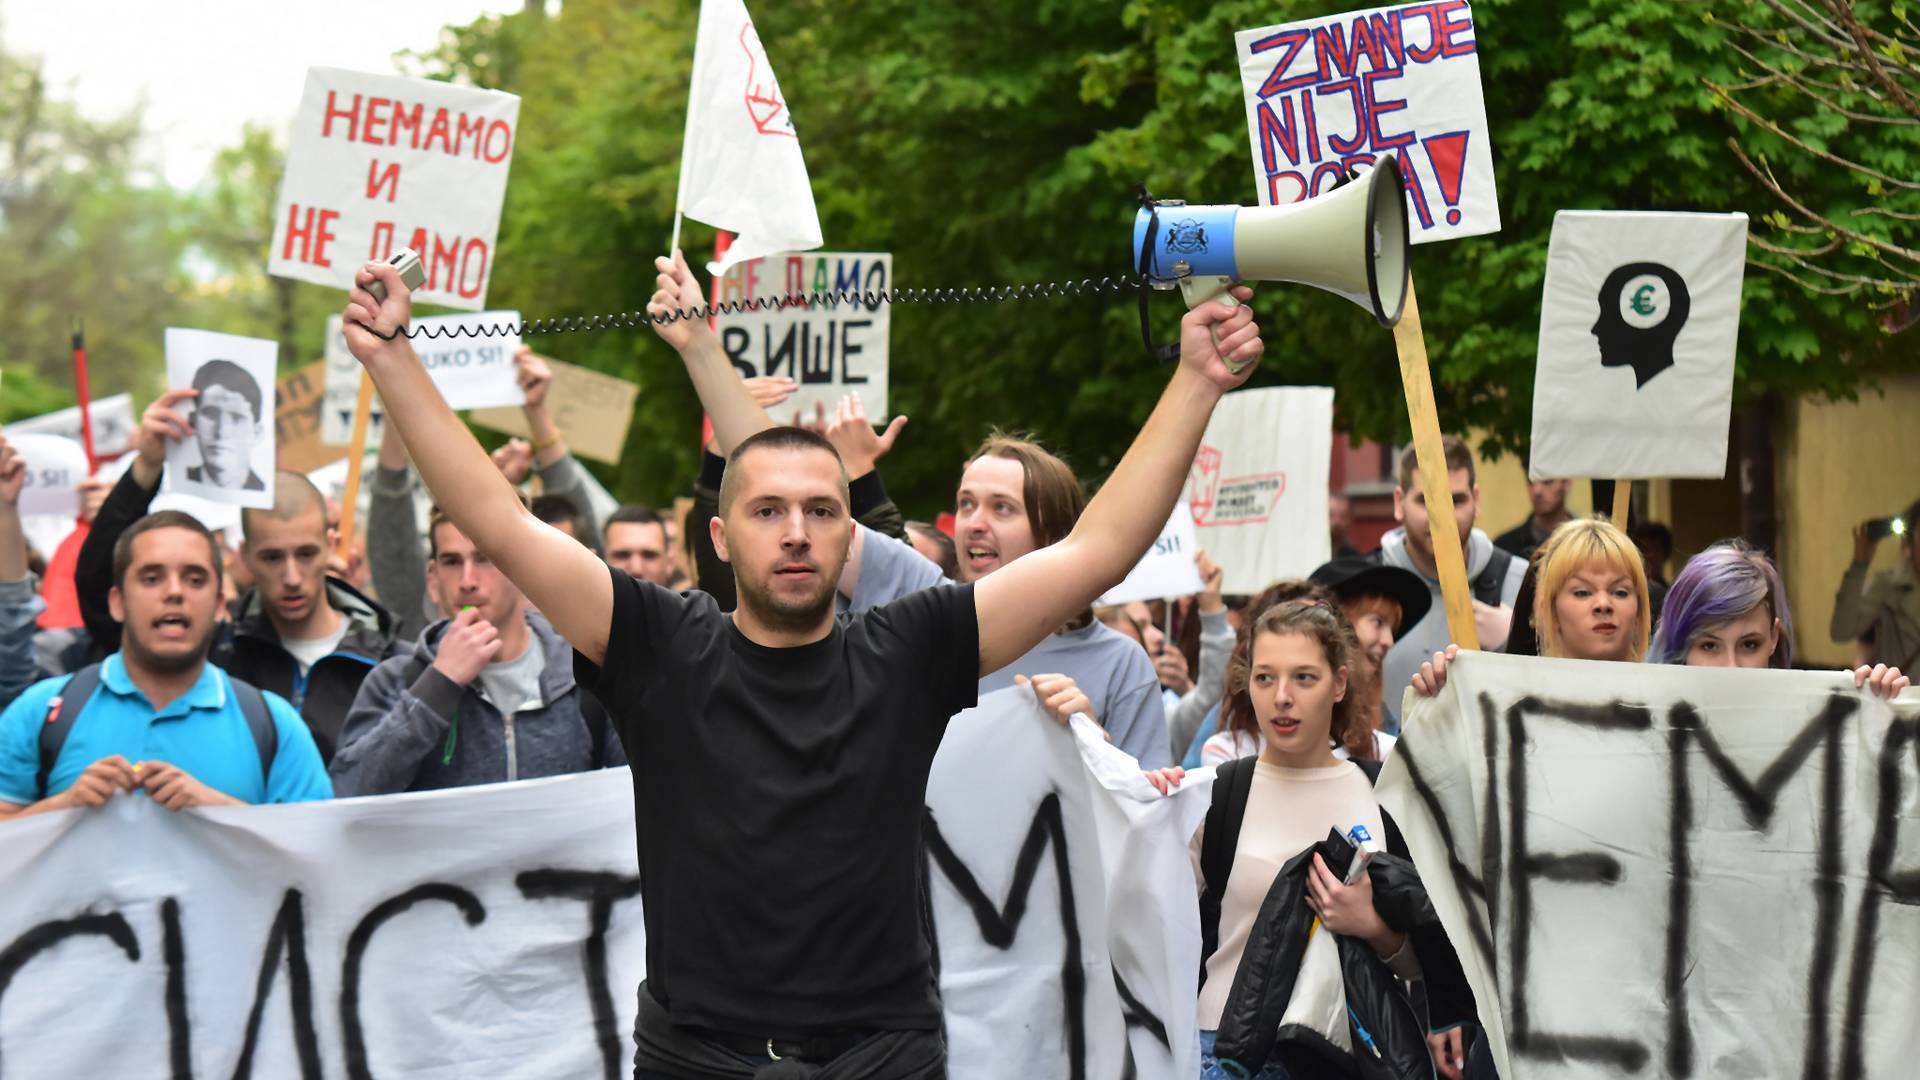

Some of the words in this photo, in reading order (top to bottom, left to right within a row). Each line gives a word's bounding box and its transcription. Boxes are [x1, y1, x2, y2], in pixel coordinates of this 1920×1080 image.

[1250, 0, 1477, 99] ZNANJE
[322, 90, 512, 163] НЕМАМО
[1257, 68, 1417, 173] NIJE
[366, 159, 401, 202] И
[282, 203, 340, 268] НЕ
[778, 255, 886, 313] ДАМО
[722, 320, 873, 385] ВИШЕ
